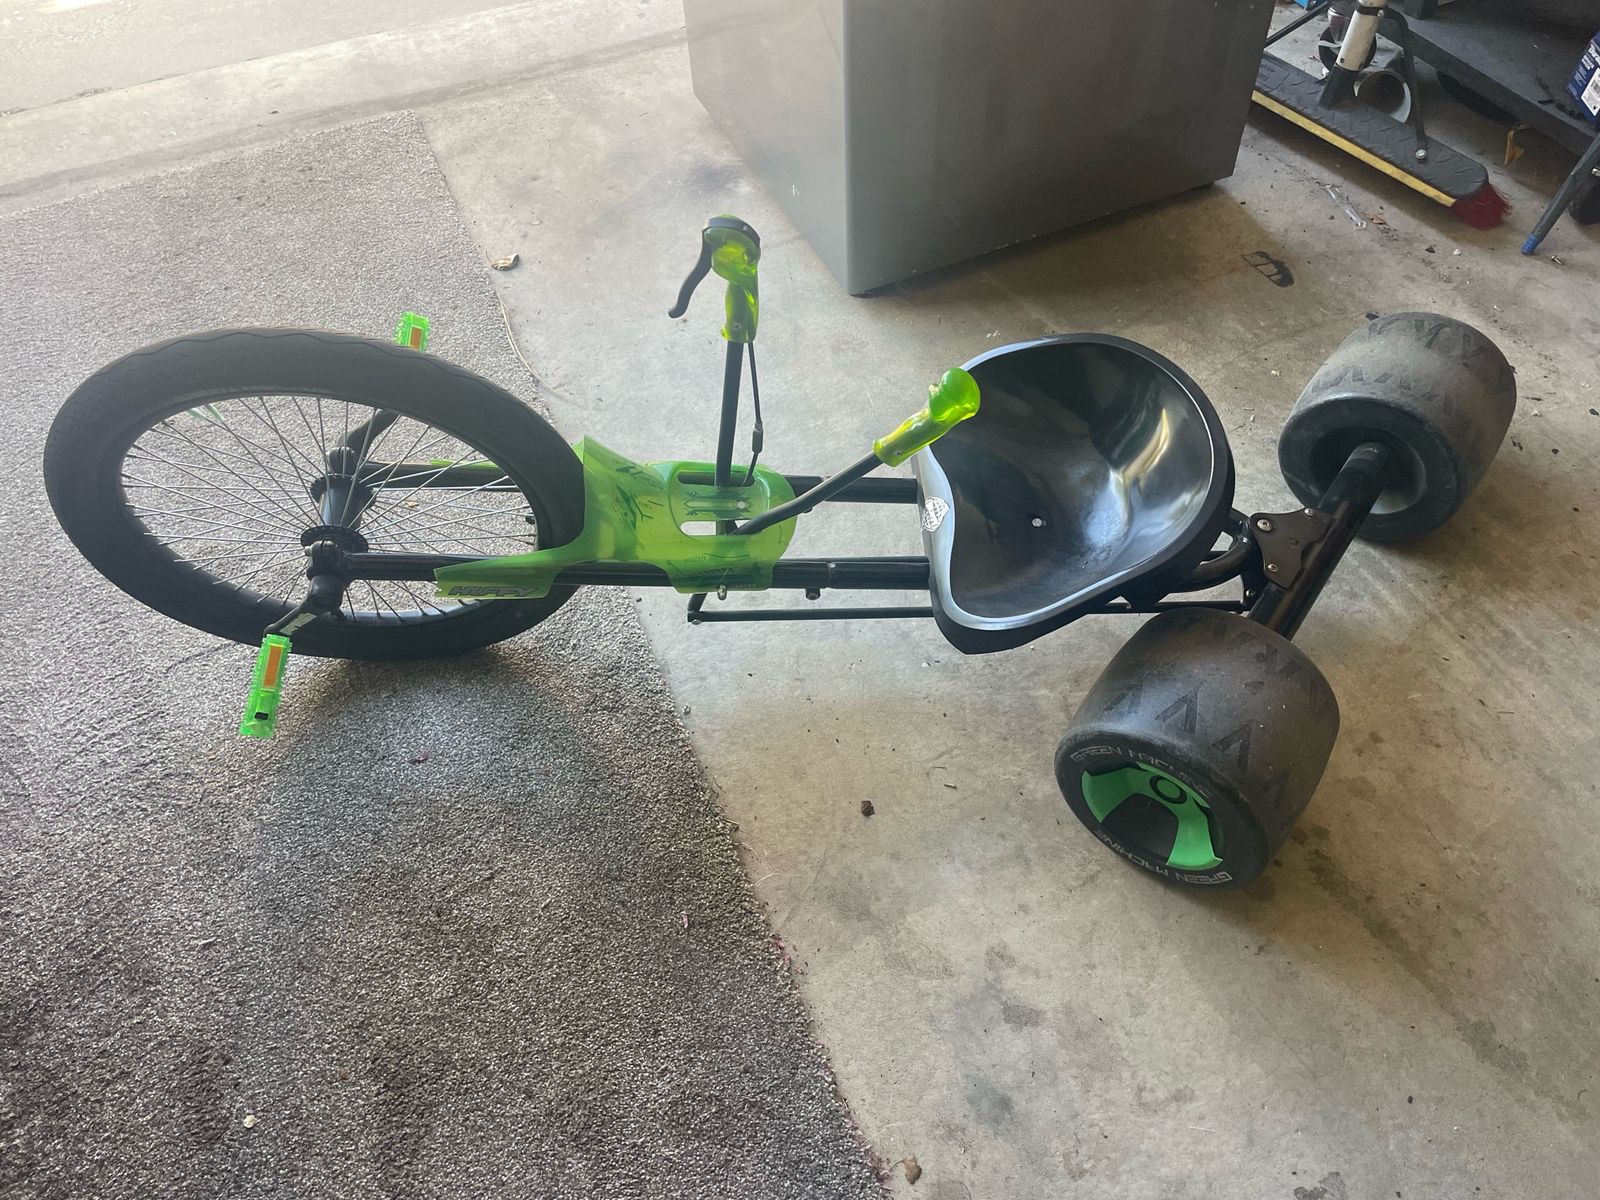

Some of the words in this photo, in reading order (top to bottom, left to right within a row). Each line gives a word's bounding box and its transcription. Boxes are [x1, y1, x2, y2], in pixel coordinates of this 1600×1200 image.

[448, 585, 538, 597] HUFFY
[1070, 746, 1122, 762] GREEN
[1176, 871, 1233, 885] GREEN
